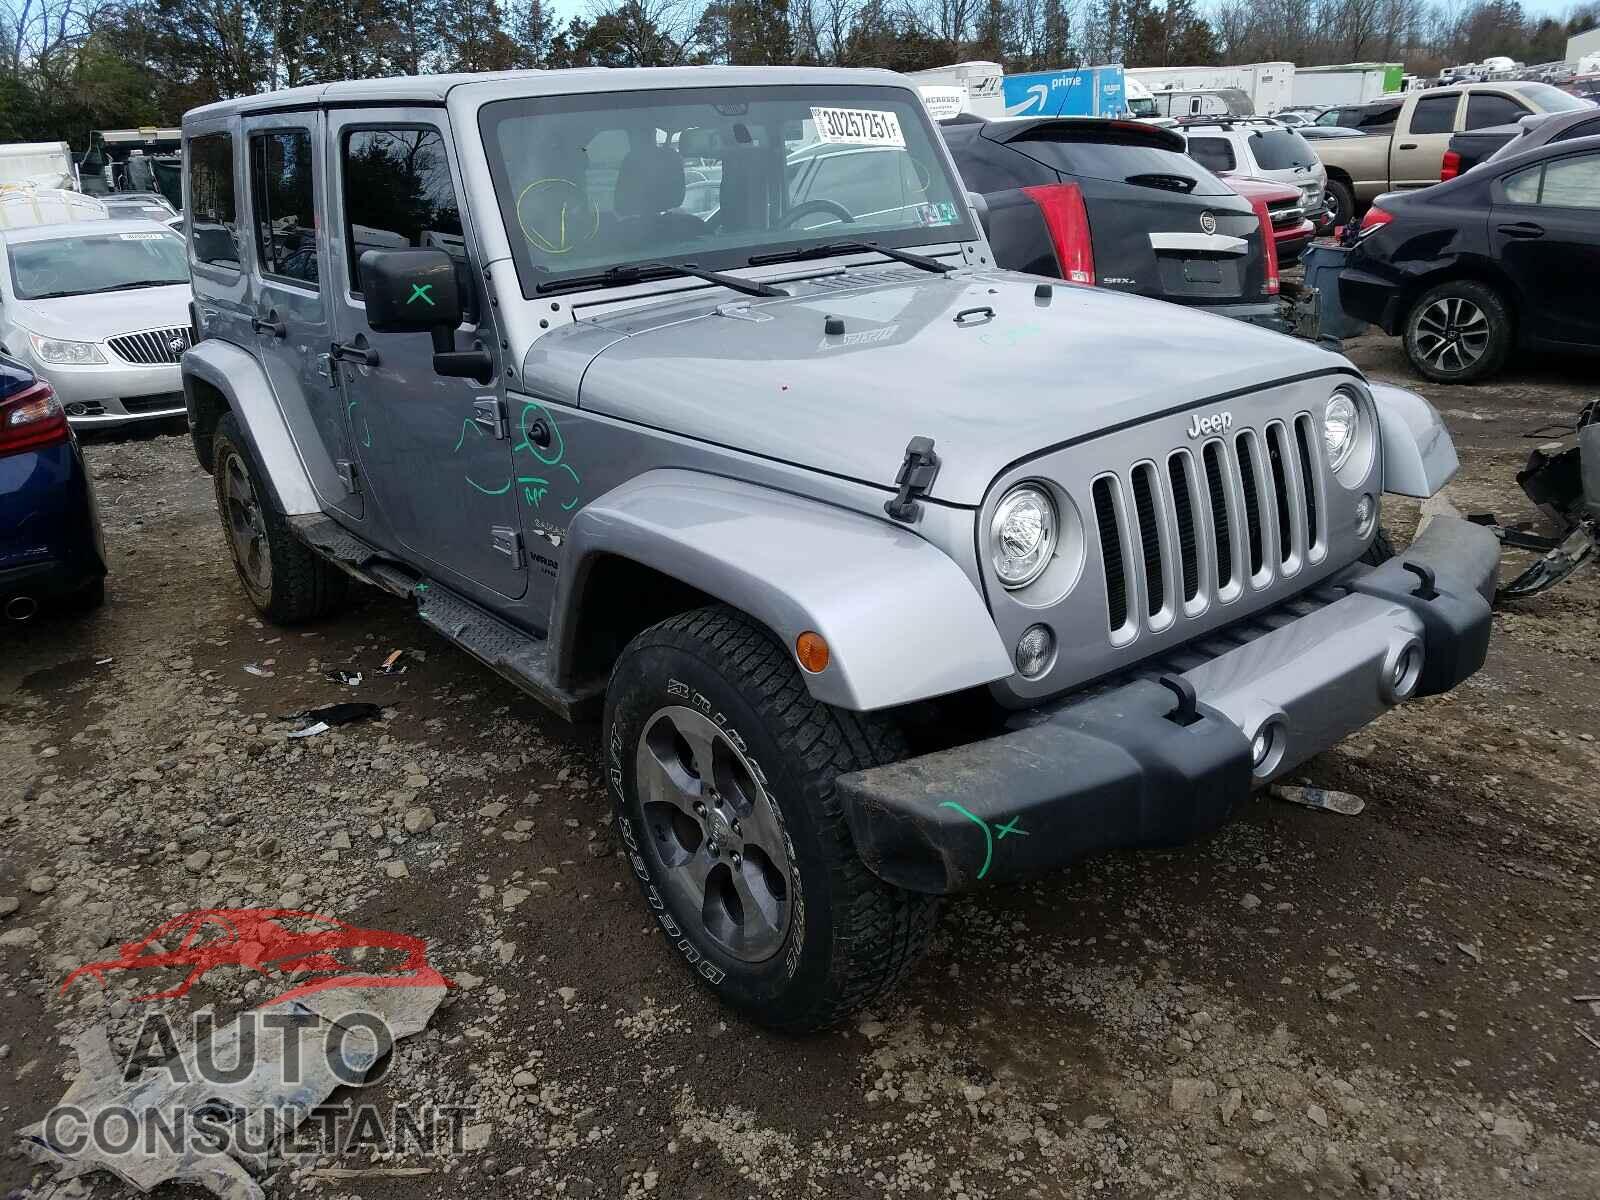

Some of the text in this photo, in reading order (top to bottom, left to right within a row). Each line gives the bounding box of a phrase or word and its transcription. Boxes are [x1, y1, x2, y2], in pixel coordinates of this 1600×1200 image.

[1052, 75, 1082, 90] prime
[823, 110, 891, 139] 30257251
[1187, 411, 1232, 439] Jeep
